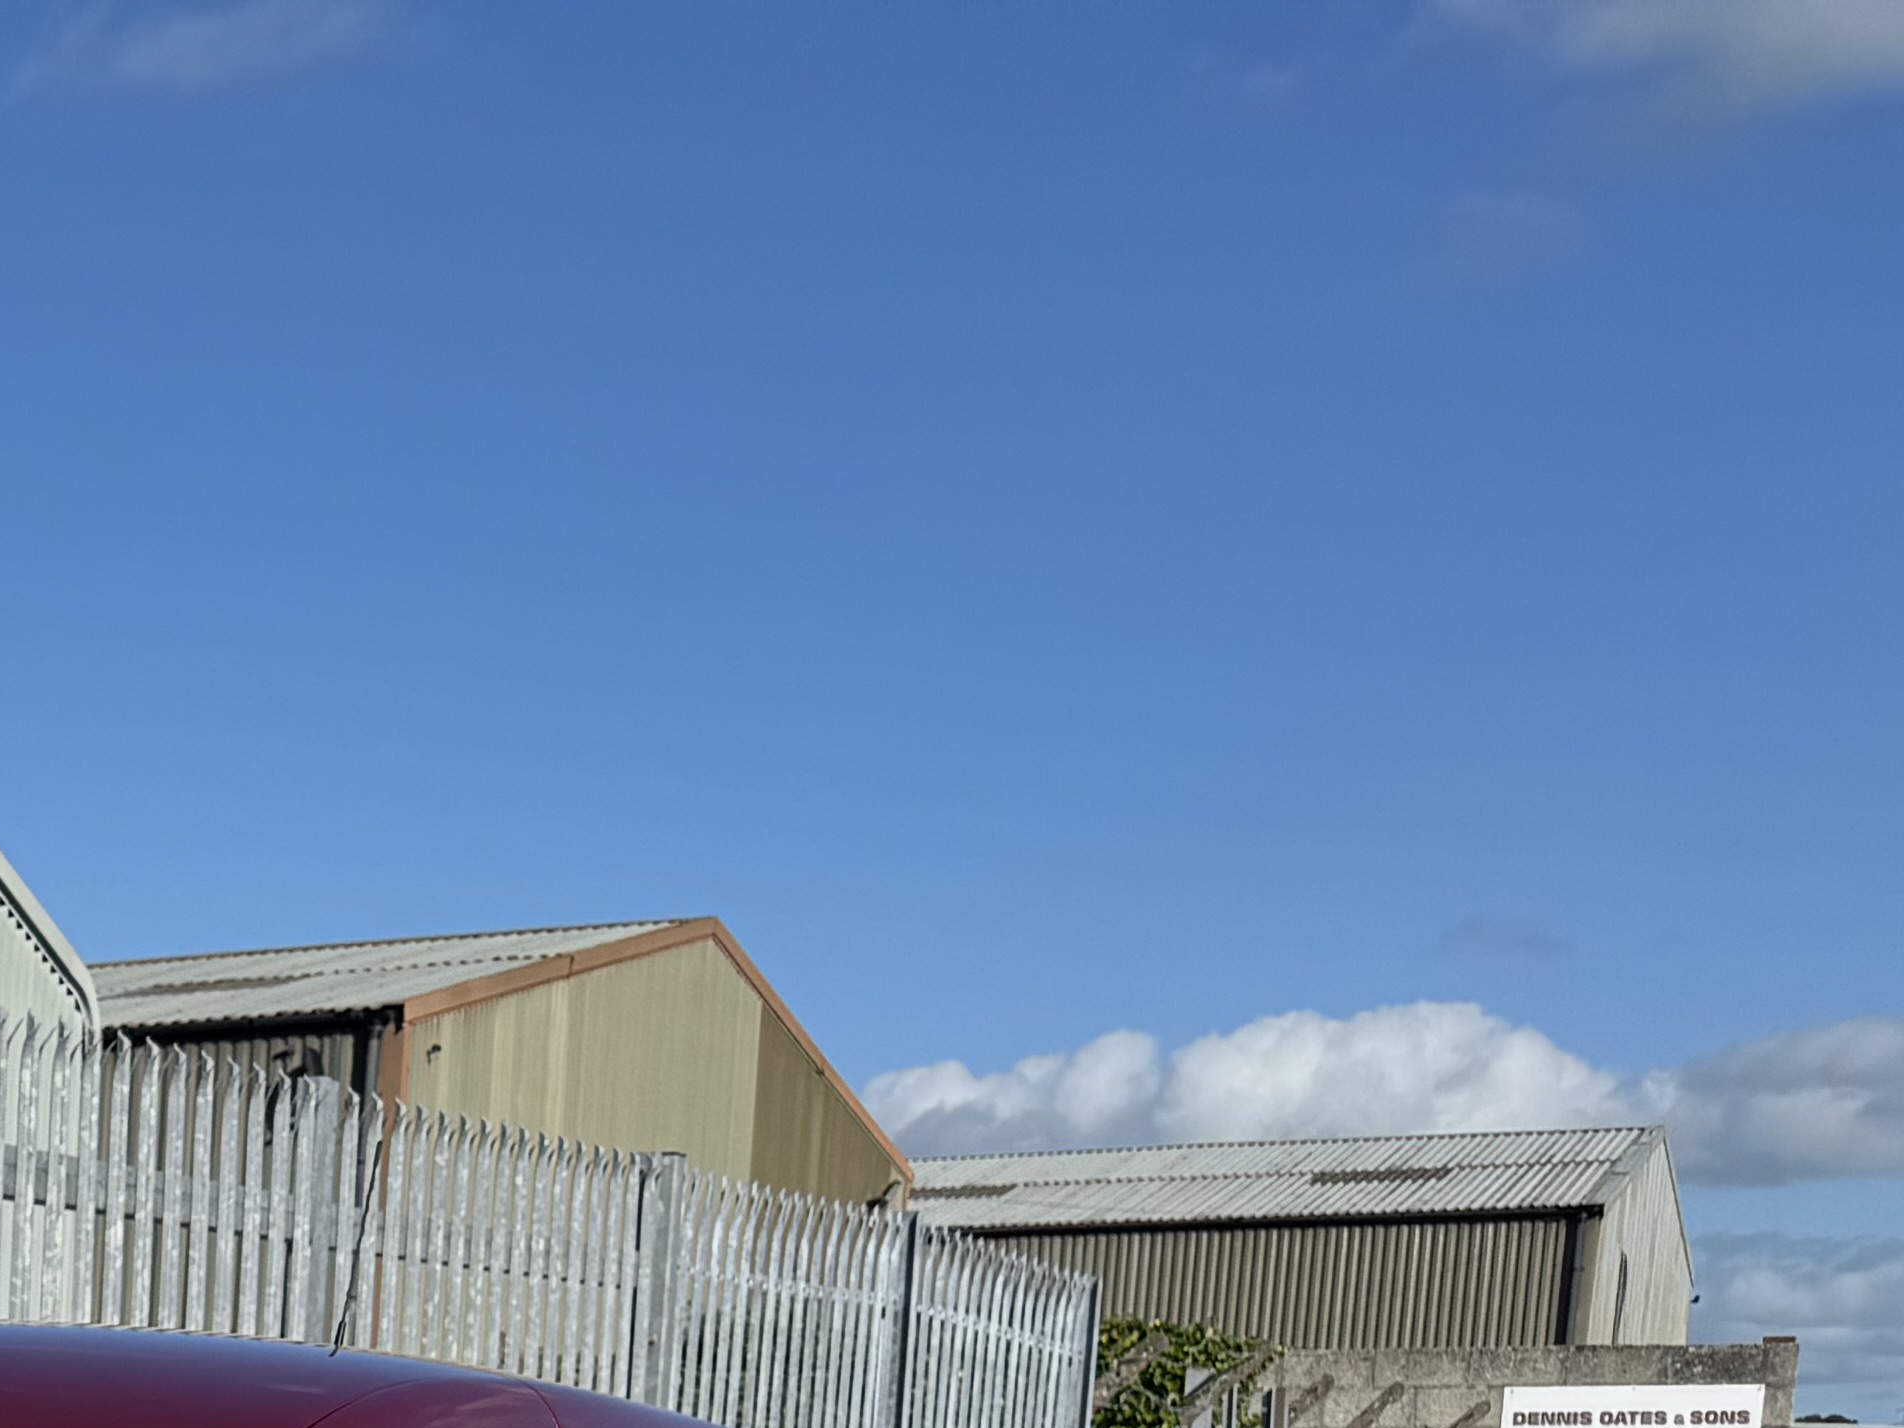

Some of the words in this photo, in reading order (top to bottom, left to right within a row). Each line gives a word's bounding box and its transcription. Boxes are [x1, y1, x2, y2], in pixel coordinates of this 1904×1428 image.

[1512, 1412, 1593, 1426] DENNIS
[1599, 1411, 1667, 1425] OATES
[1690, 1410, 1751, 1425] SONS
